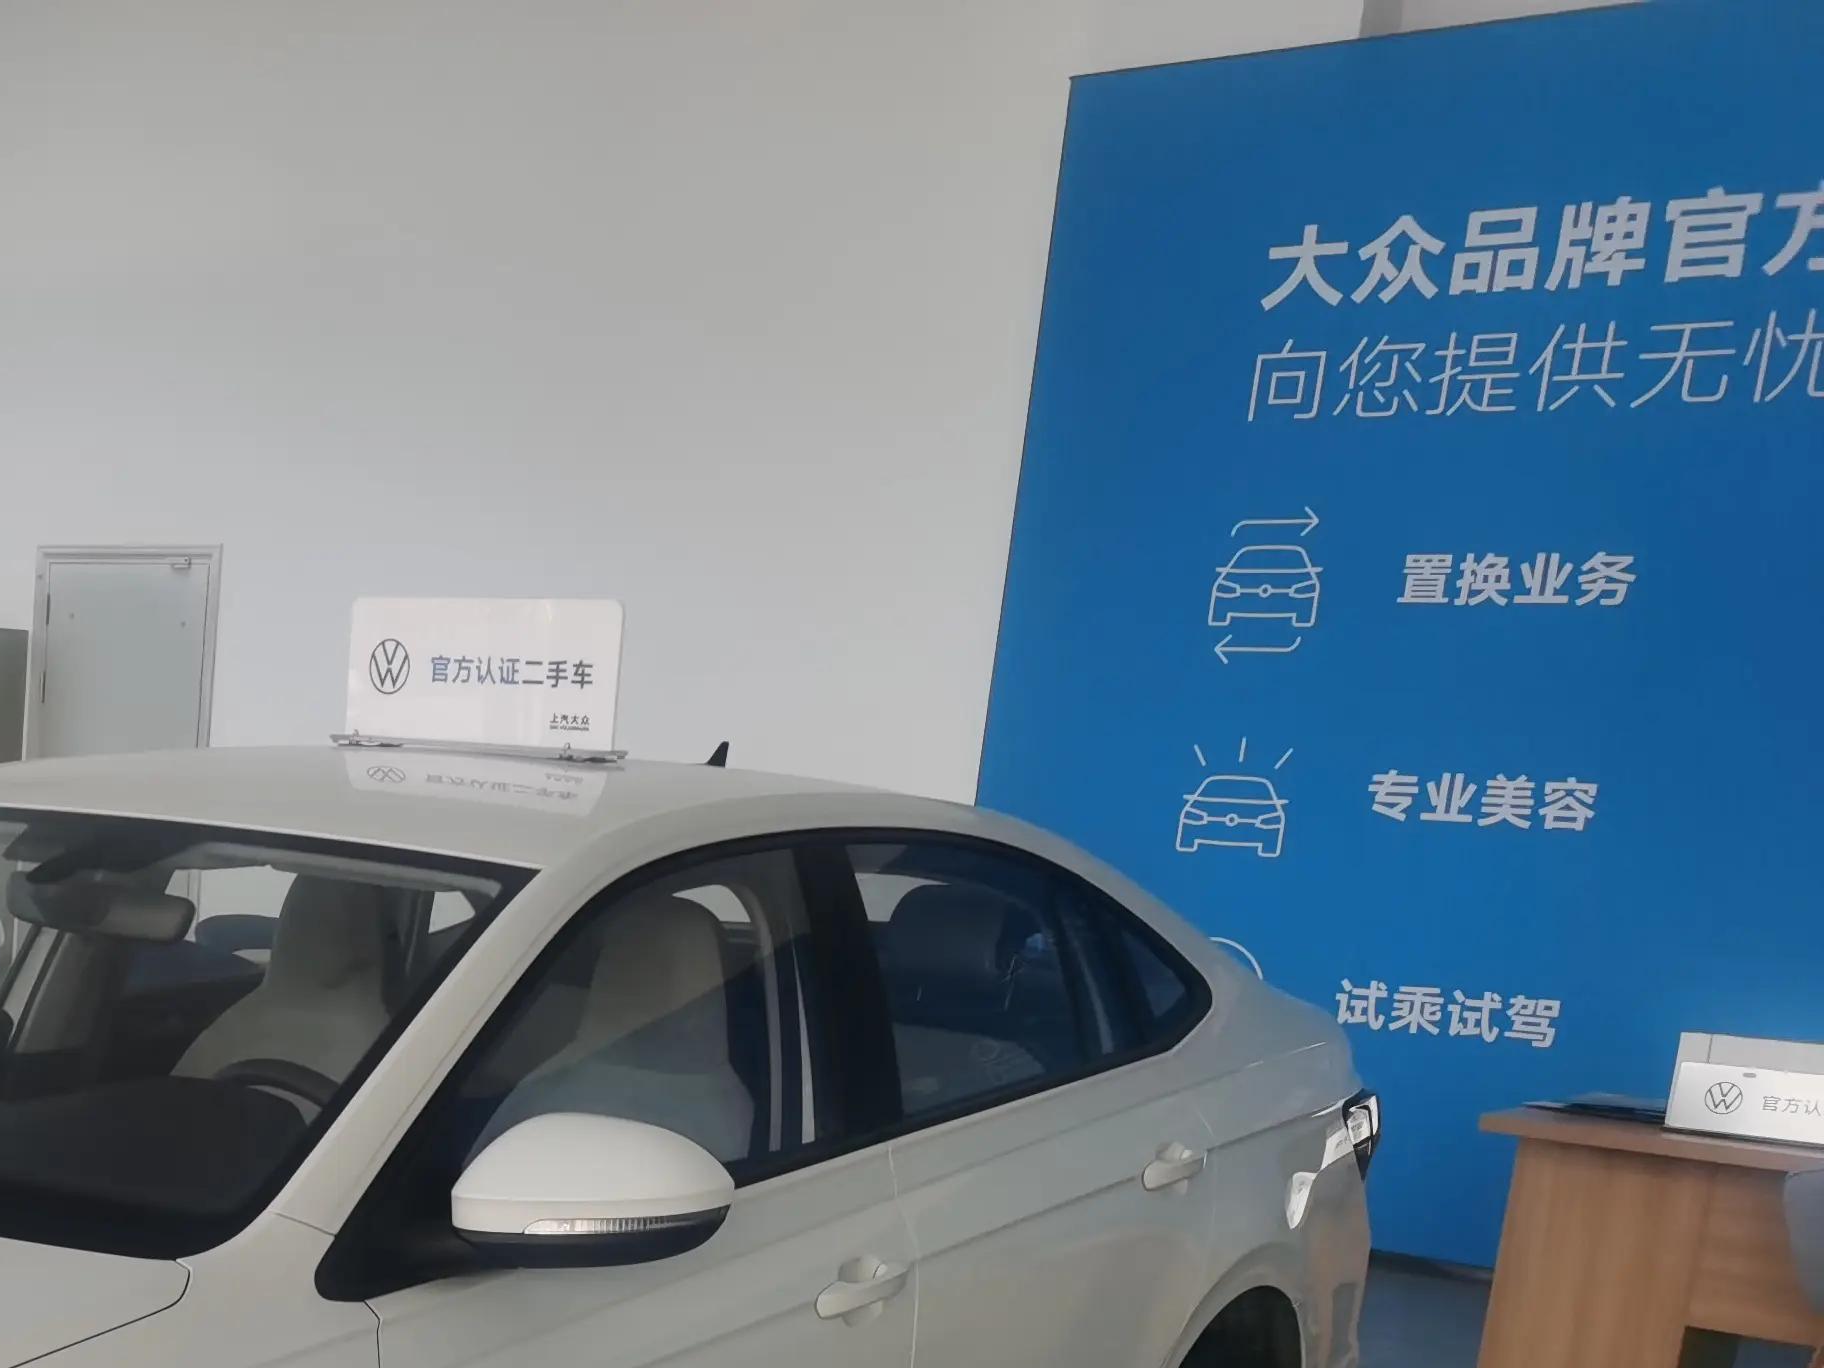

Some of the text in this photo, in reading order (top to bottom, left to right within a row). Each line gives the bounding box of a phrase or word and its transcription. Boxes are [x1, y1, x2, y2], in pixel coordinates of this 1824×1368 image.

[1247, 309, 1824, 423] 向您提供无忧
[1397, 552, 1638, 607] 置换业务
[431, 655, 593, 690] 官方认证二手车
[549, 712, 590, 725] 上汽大众
[1367, 769, 1599, 832] 专业美容
[1335, 979, 1562, 1049] 试乘试驾
